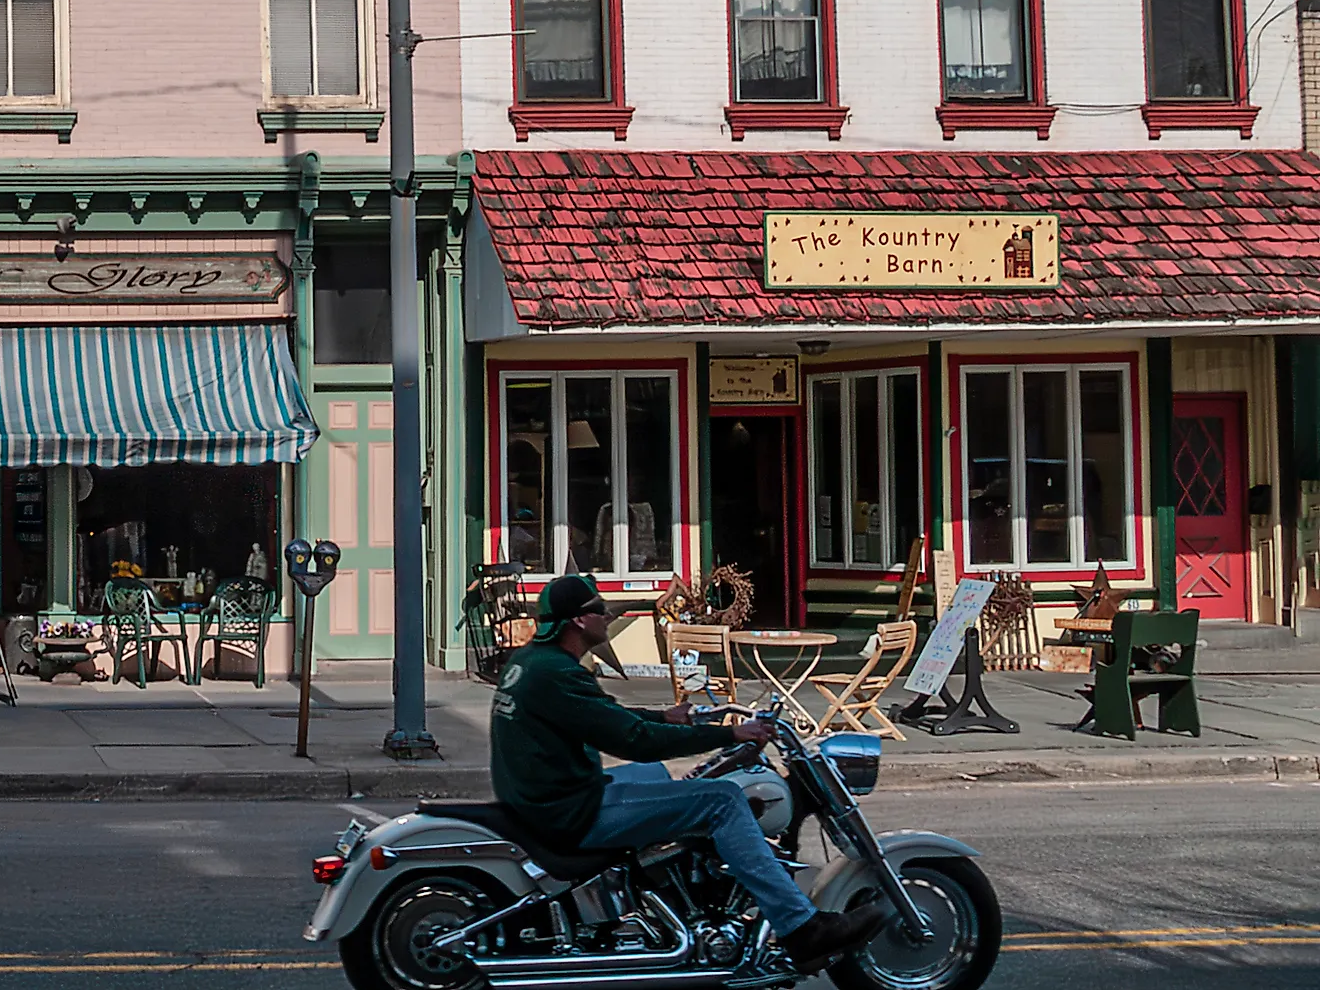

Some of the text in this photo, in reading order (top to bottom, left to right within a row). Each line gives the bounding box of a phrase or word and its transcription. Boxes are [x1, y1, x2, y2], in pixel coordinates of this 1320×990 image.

[791, 227, 960, 255] The Kountry
[887, 254, 943, 273] Barn
[47, 262, 221, 294] Glory
